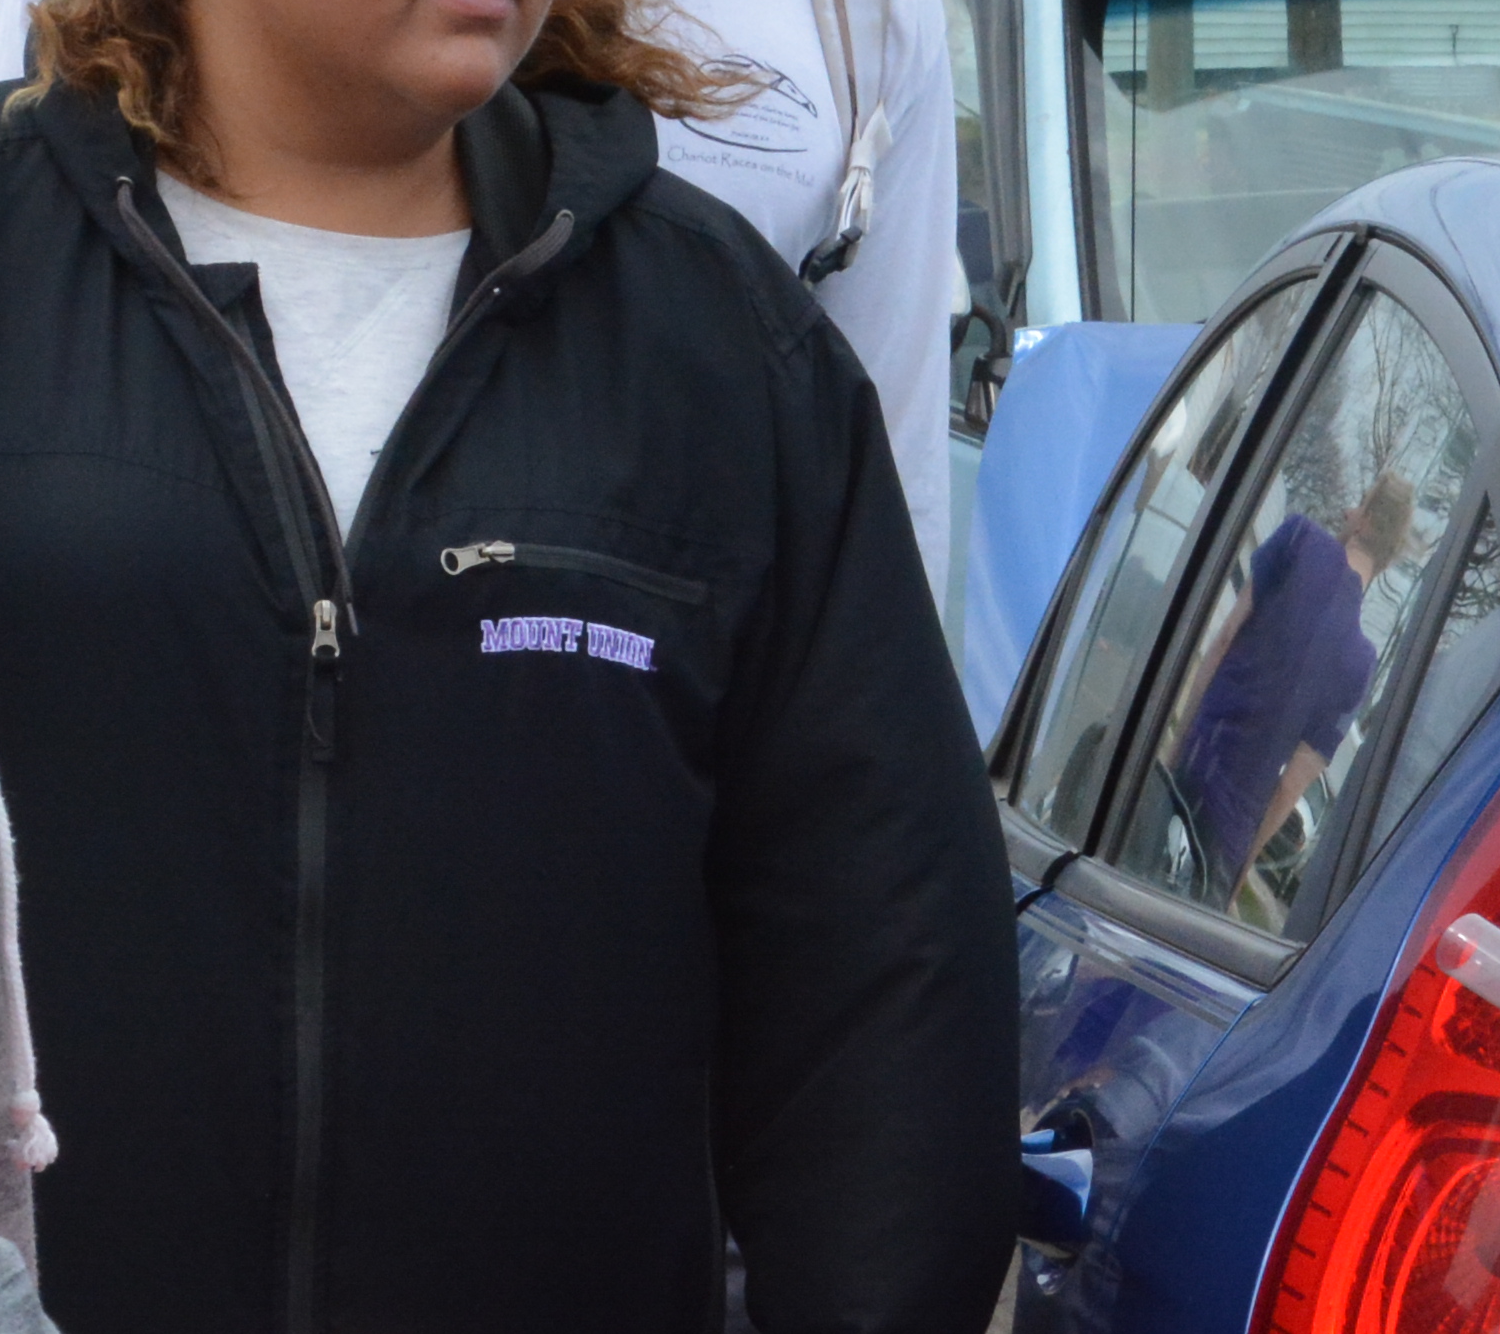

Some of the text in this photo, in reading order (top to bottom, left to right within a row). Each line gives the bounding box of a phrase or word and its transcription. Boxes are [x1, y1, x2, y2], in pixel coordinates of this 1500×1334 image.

[667, 146, 717, 164] Chariot
[721, 152, 757, 169] Races
[481, 617, 655, 670] MOUNT UNION
